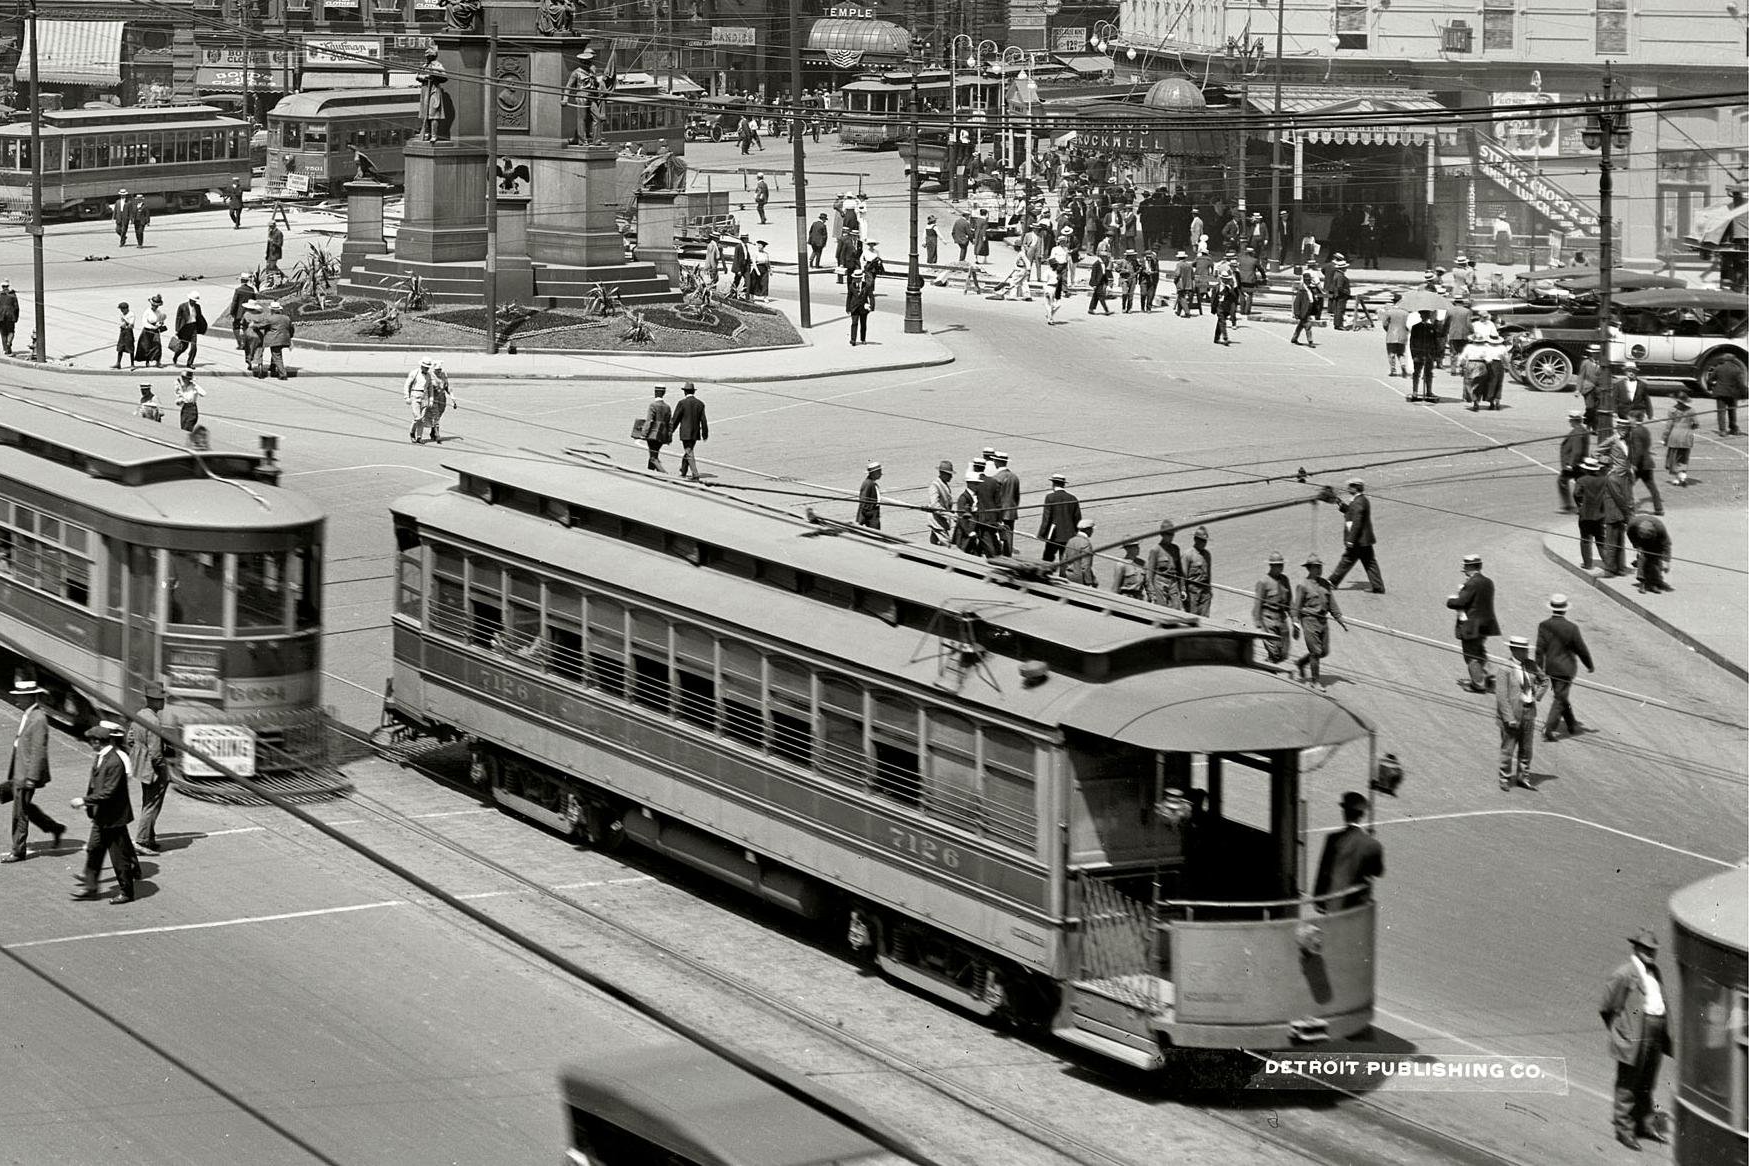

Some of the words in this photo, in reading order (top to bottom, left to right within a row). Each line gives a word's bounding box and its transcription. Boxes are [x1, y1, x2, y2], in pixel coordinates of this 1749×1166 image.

[822, 7, 873, 18] TEMPLE
[1077, 133, 1164, 150] ROCKWELL
[481, 670, 529, 700] 7126
[889, 826, 960, 869] 7126
